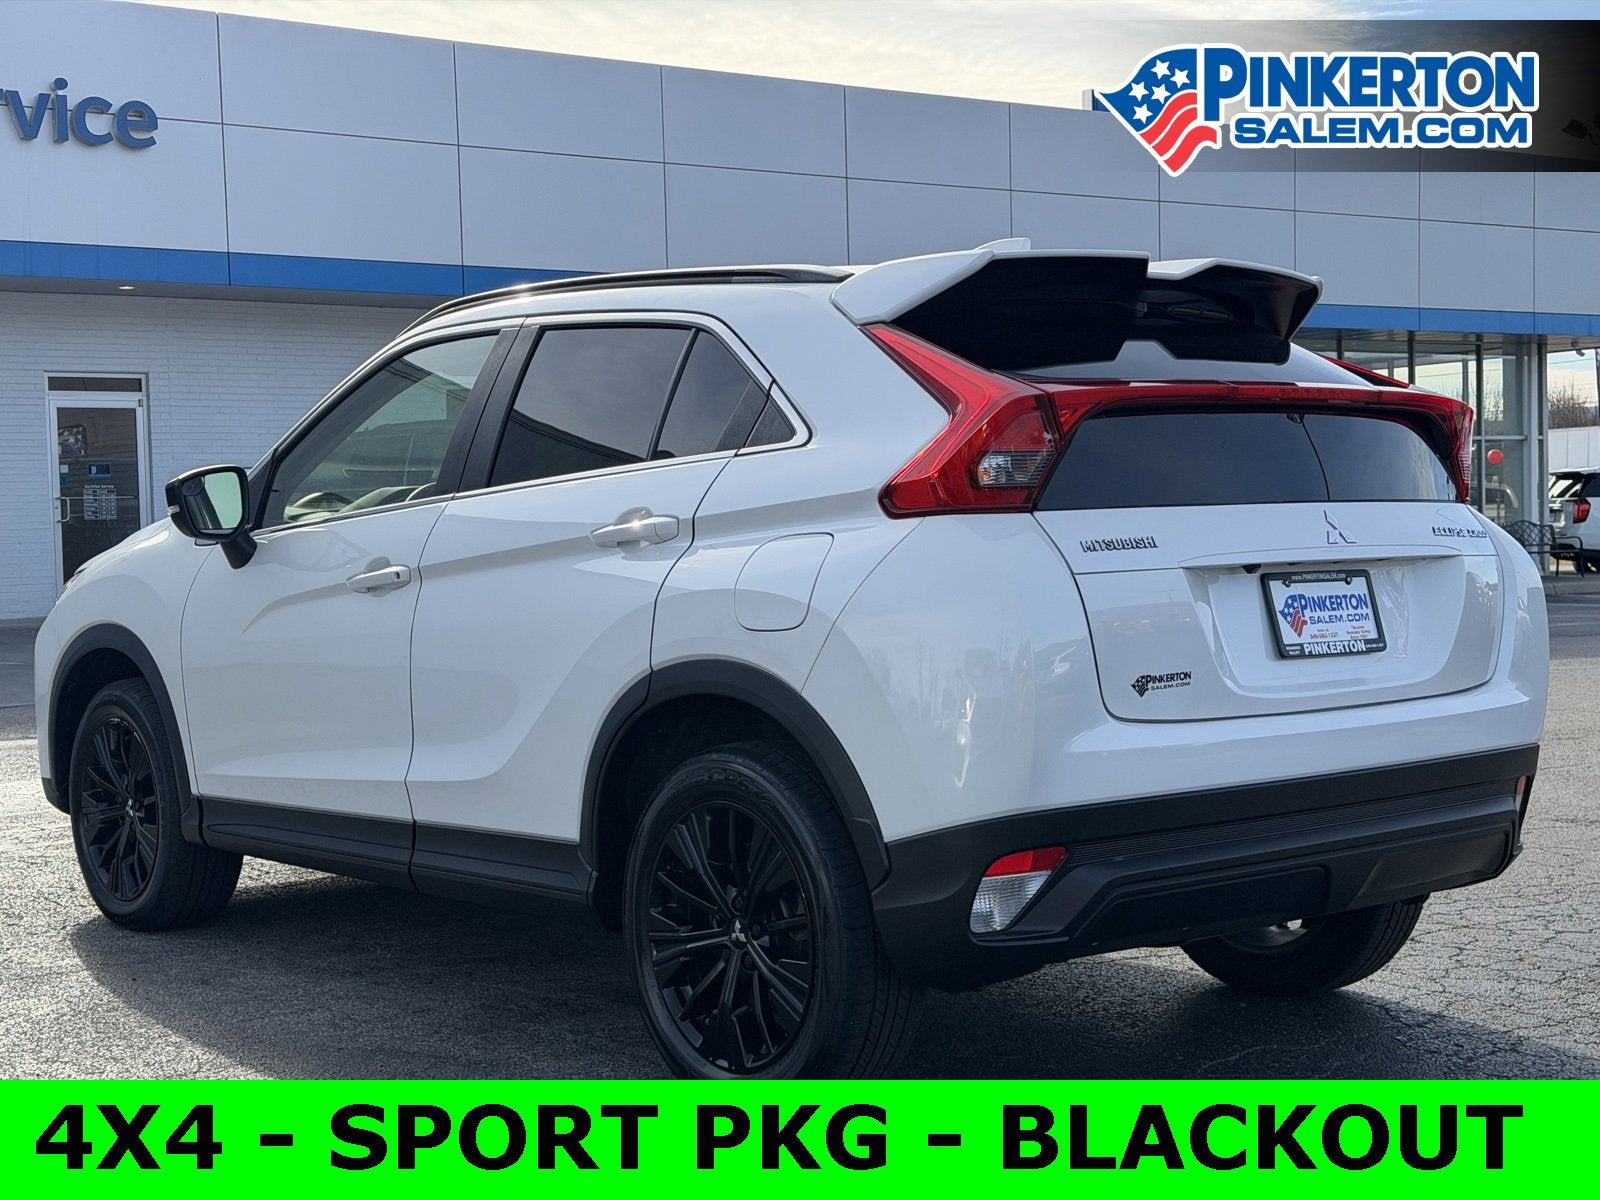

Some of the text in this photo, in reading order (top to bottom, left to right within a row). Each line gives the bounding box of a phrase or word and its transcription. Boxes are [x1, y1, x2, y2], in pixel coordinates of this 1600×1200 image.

[0, 77, 158, 150] vice
[1080, 536, 1158, 552] MITSUBISHI
[1298, 593, 1369, 618] PINKERTON
[1308, 613, 1370, 625] SALEM.COM
[1303, 640, 1367, 656] PINKERTON
[1145, 671, 1192, 687] PINKERTON
[1150, 681, 1191, 690] SALEM.COM
